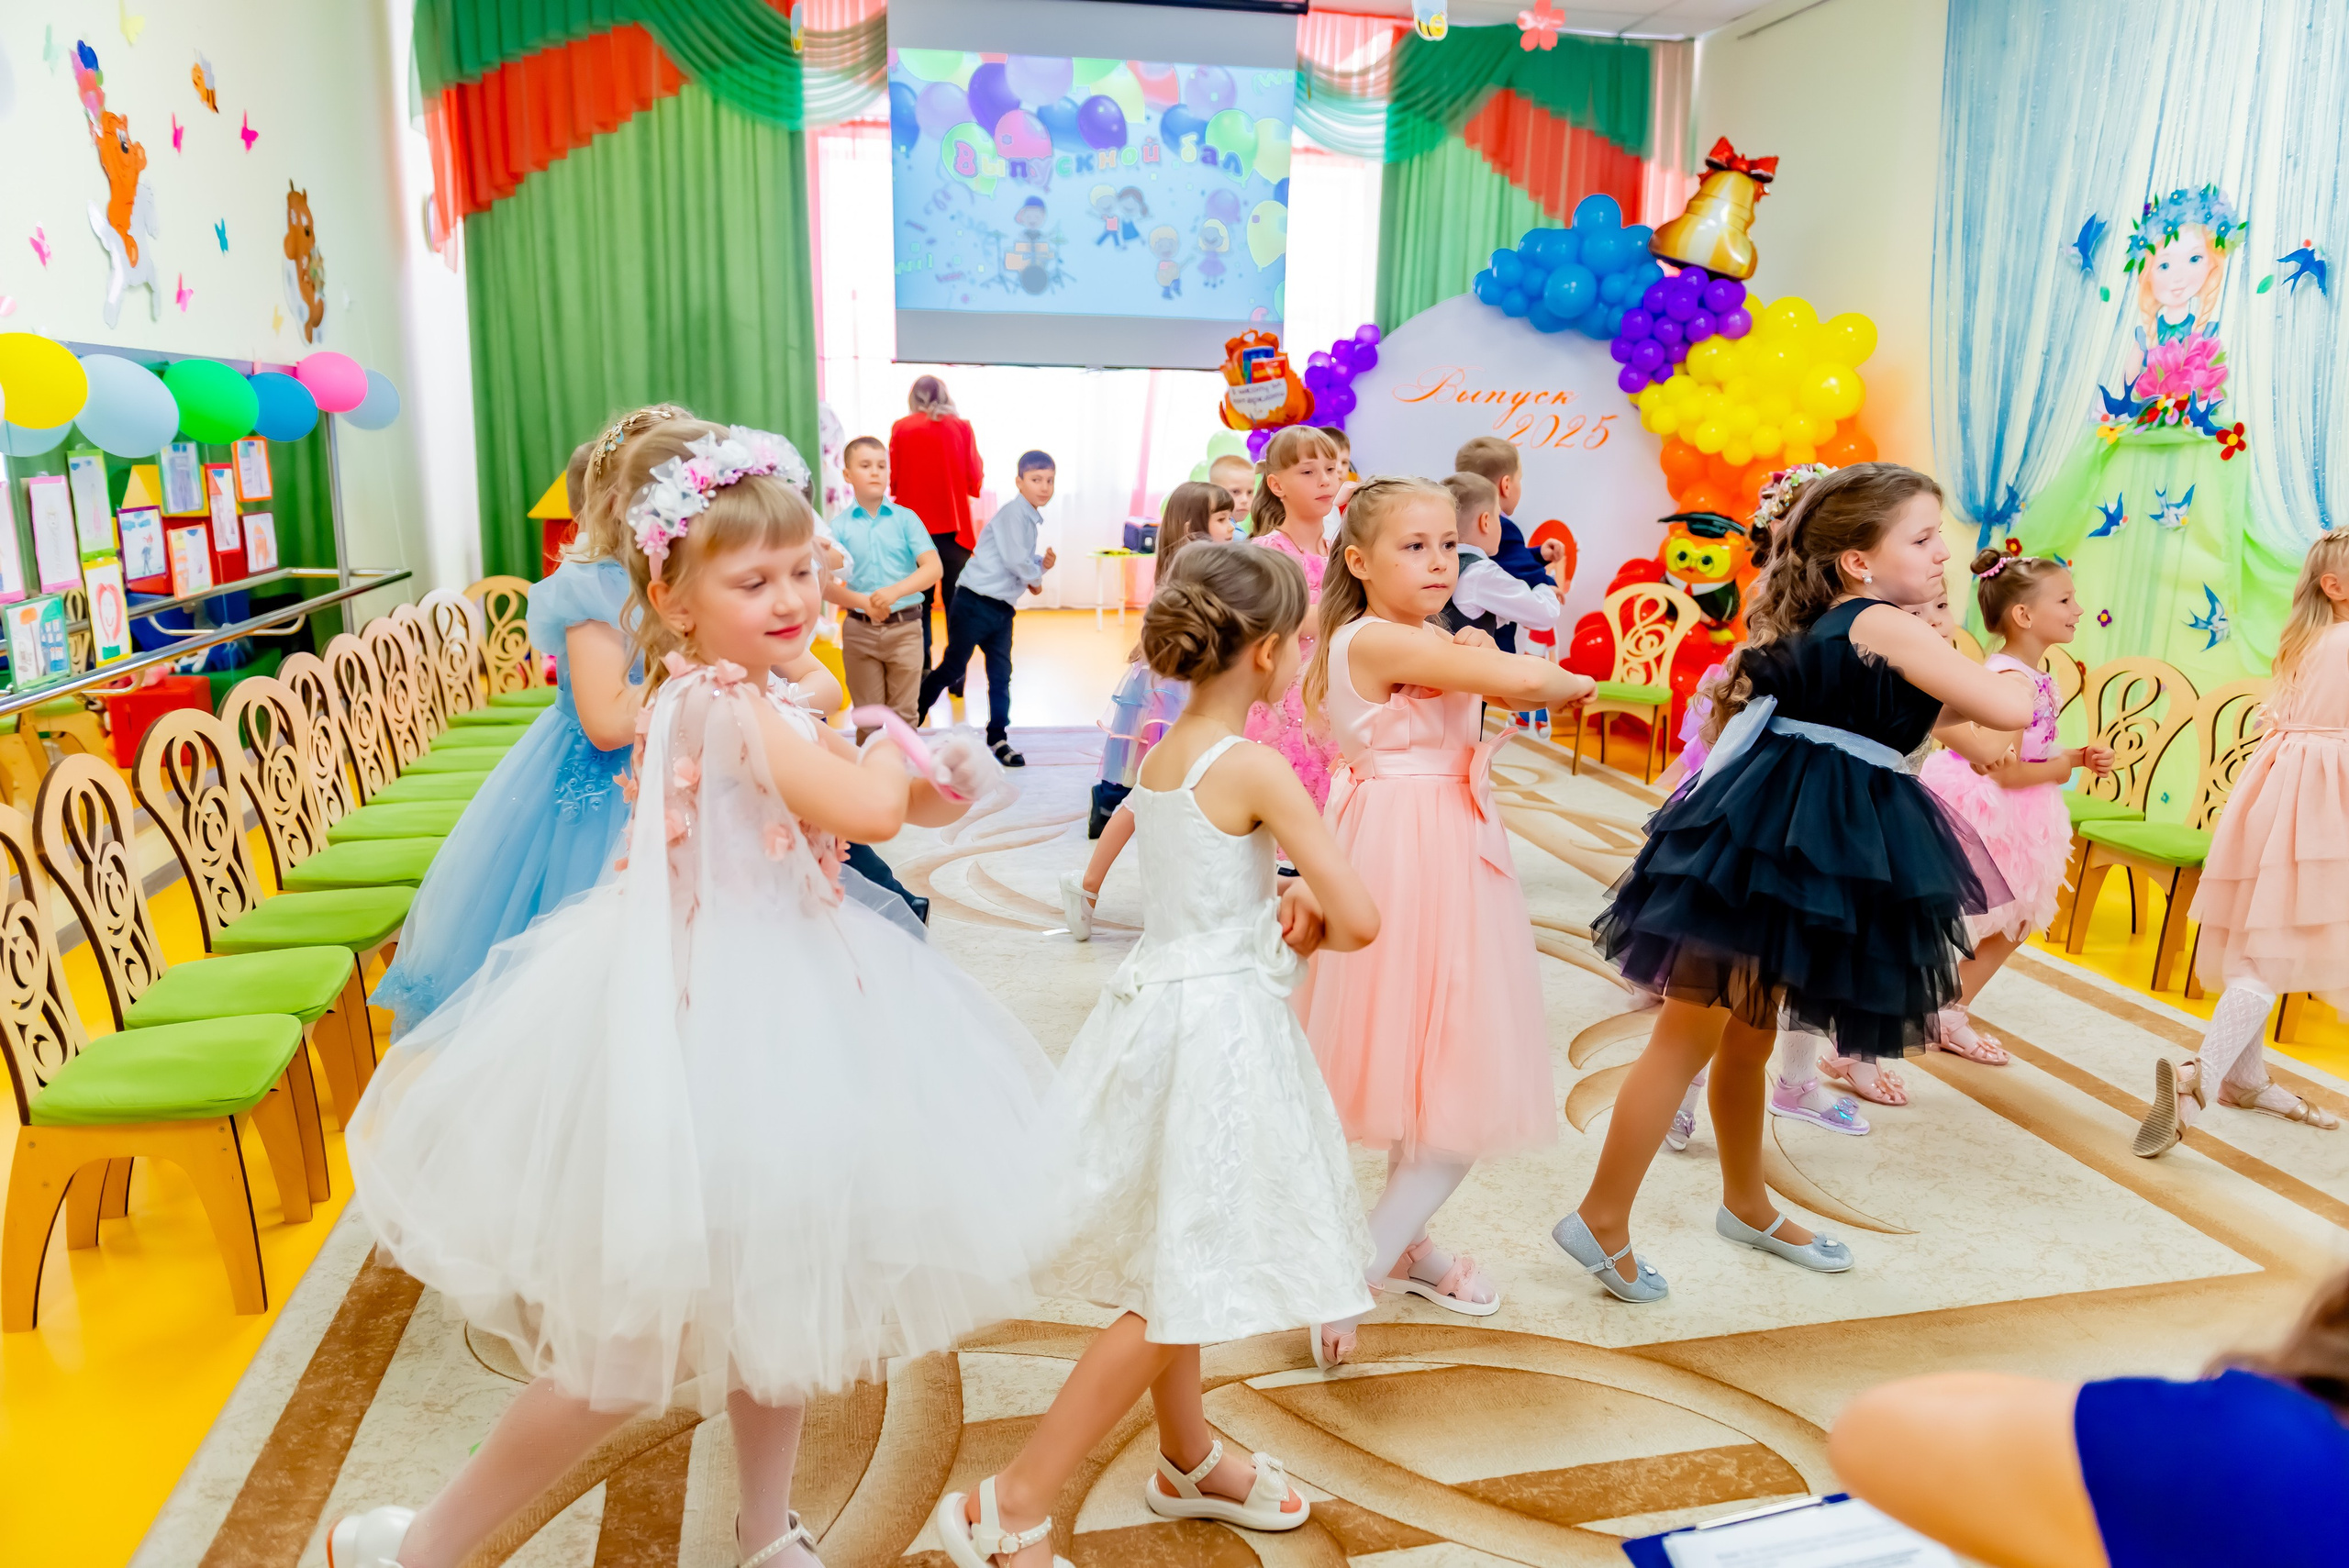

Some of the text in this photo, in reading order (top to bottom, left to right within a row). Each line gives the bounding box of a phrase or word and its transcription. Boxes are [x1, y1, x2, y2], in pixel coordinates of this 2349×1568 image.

[1180, 133, 1243, 177] бал
[1391, 364, 1580, 430] Выпуск
[1506, 413, 1619, 450] 2025
